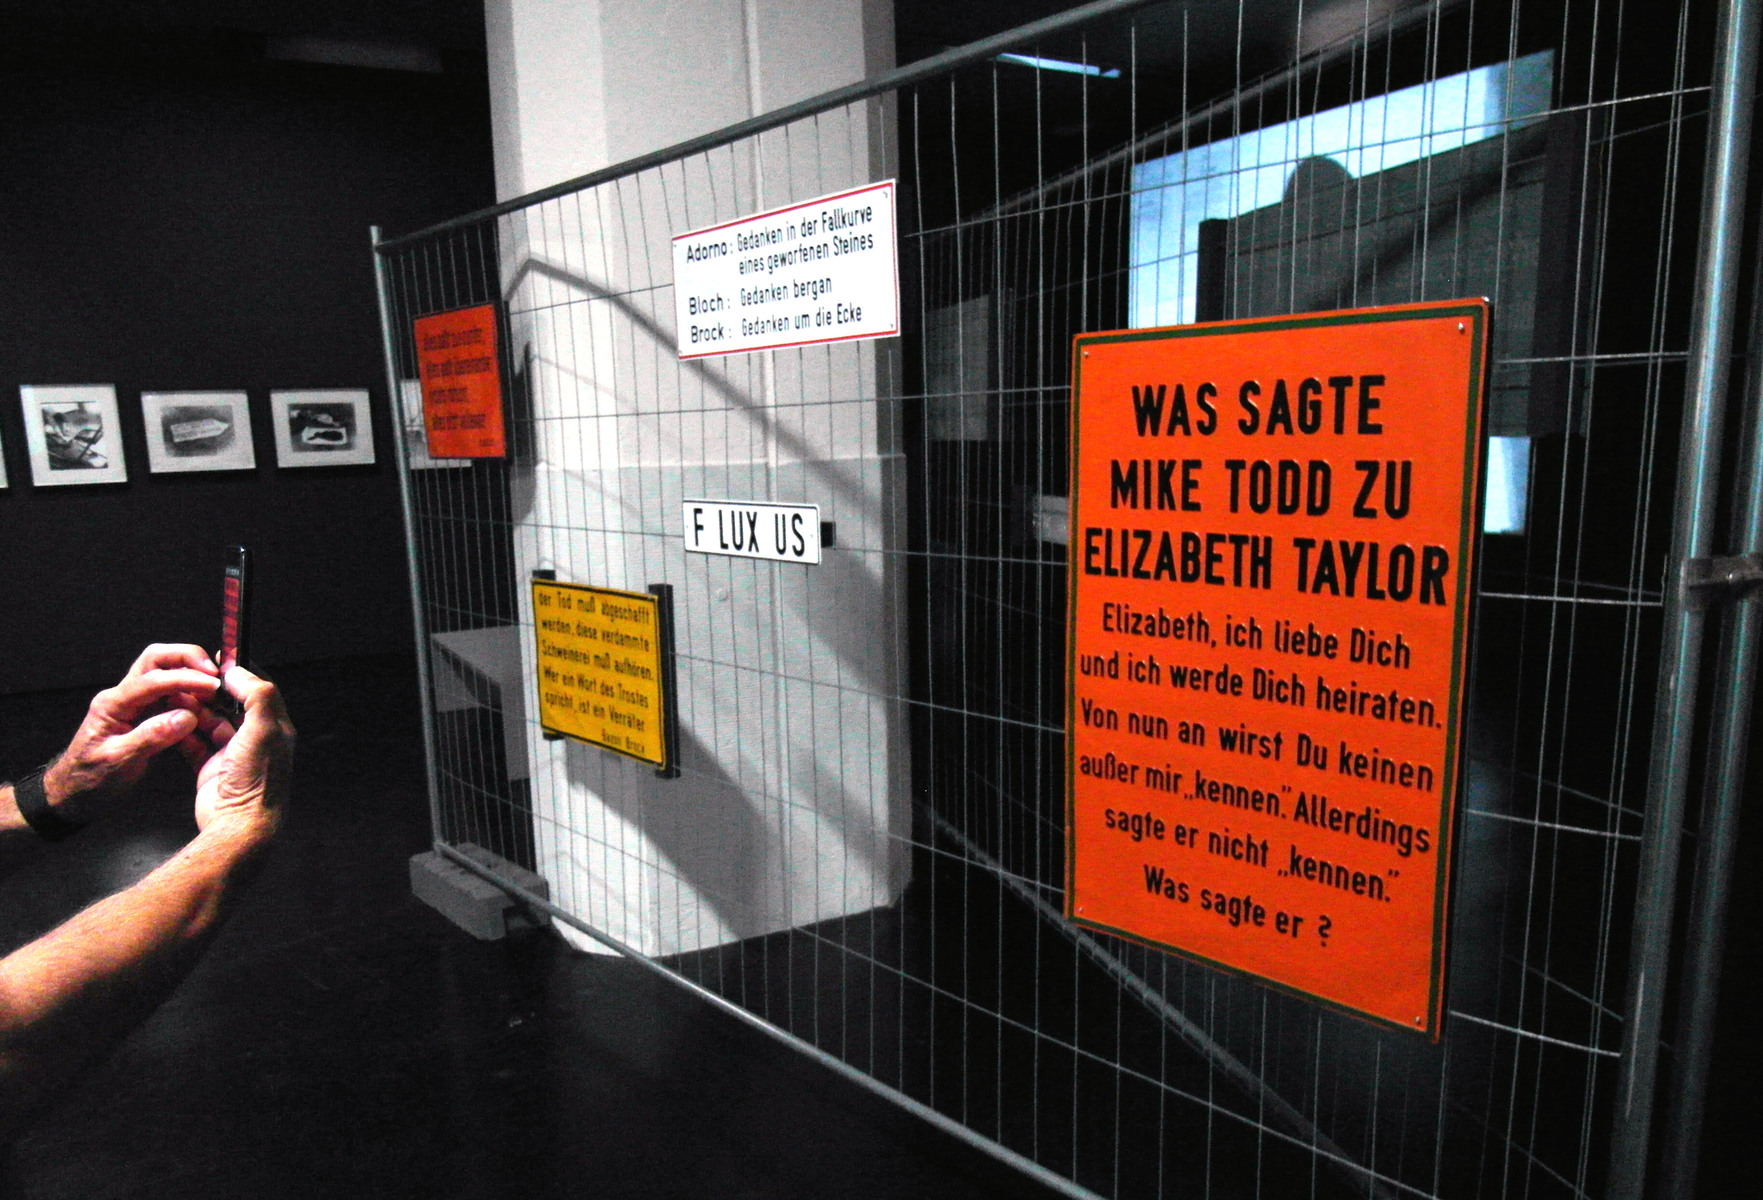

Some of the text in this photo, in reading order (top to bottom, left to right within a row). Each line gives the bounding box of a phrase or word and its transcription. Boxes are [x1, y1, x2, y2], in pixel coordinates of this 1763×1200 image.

[737, 226, 783, 252] Gedanken
[786, 221, 796, 241] in
[801, 217, 817, 237] der
[822, 206, 872, 233] Fallkurve
[739, 231, 873, 275] eines geworfenen Steines
[740, 283, 788, 306] Gedanken
[793, 276, 832, 300] bergan
[742, 314, 789, 337] Gedanken
[795, 314, 810, 330] um
[816, 307, 831, 326] die
[837, 303, 862, 324] Ecke
[1132, 374, 1385, 437] WAS SAGTE
[1111, 459, 1412, 519] MIKE TODD ZU
[1085, 527, 1449, 606] ELIZABETH TAYLOR
[557, 592, 572, 609] Tod
[577, 596, 595, 613] muß
[601, 600, 650, 625] abgeschafft
[576, 625, 597, 640] diese
[602, 629, 649, 652] verdammte
[1102, 601, 1411, 669] Elizabeth, ich liebe Dich
[543, 665, 559, 684] Wer
[578, 674, 597, 693] Wort
[601, 680, 614, 698] des
[618, 683, 649, 708] Trostes
[1080, 652, 1442, 729] und ich werde Dich heiraten.
[1081, 697, 1434, 792] Von nun an wirst Du keinen
[1080, 751, 1140, 785] außer
[1145, 764, 1183, 795] mir
[1293, 791, 1431, 858] Allerdings
[1105, 807, 1165, 843] sagte
[1174, 822, 1199, 849] er
[1208, 827, 1269, 869] nicht
[1144, 863, 1190, 904] Was
[1200, 884, 1266, 927] sagte
[1275, 907, 1304, 939] er
